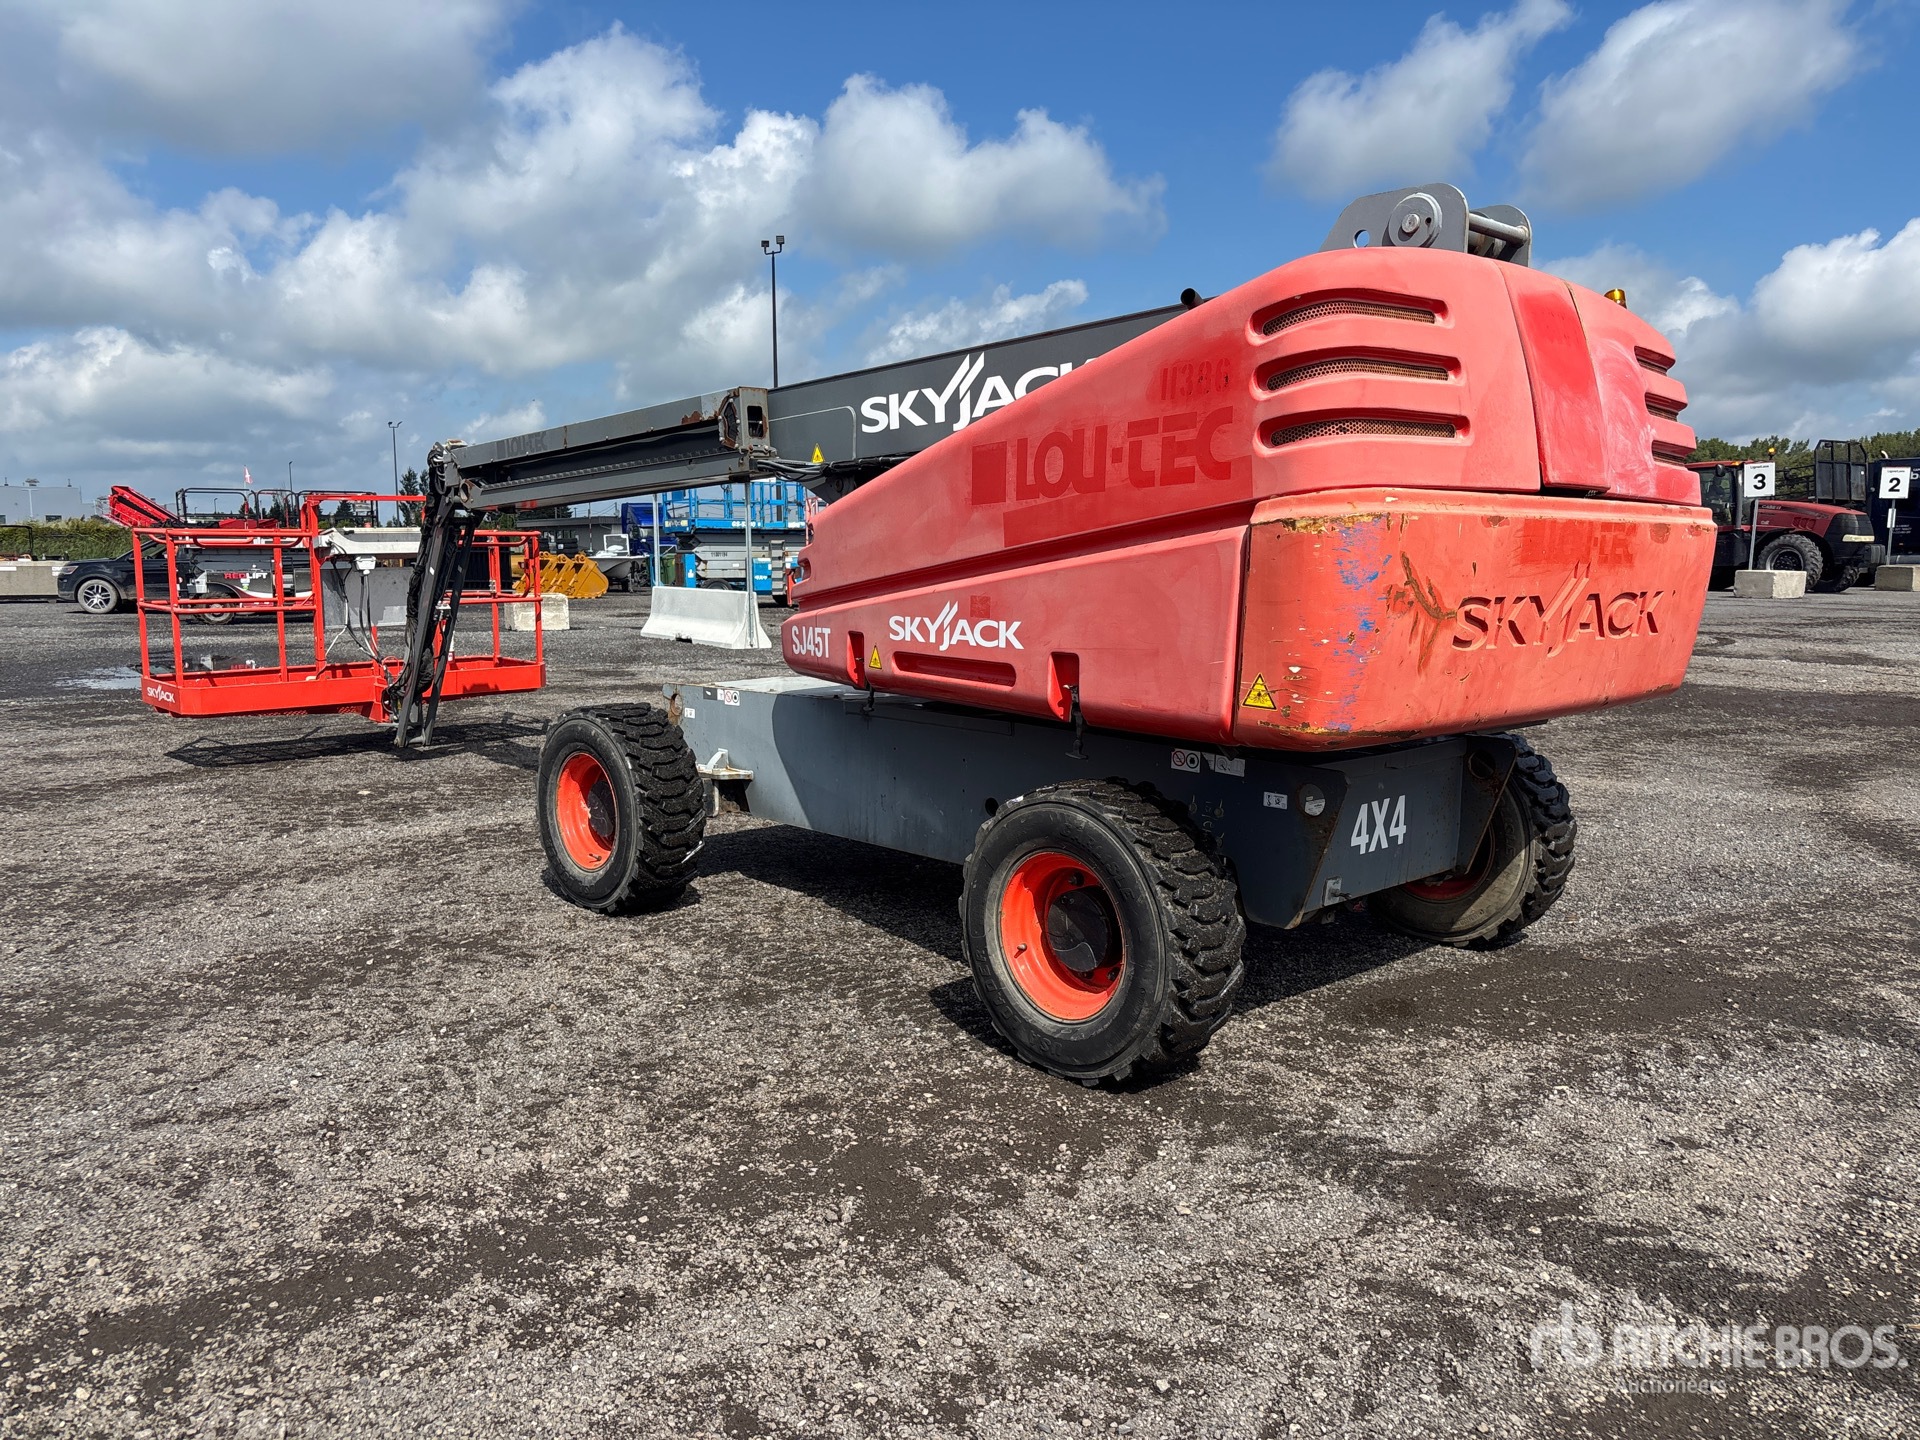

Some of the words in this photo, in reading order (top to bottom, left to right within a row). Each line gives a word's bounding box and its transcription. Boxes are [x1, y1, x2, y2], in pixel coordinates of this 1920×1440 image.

[860, 351, 1098, 433] SKYJAC
[1753, 473, 1766, 490] 3
[1888, 477, 1901, 492] 2
[888, 600, 1024, 651] SKYJACK
[1451, 560, 1664, 657] SKYJACK
[791, 625, 831, 659] SJ45T
[146, 684, 176, 703] SKYJACK
[1351, 795, 1407, 855] 4X4
